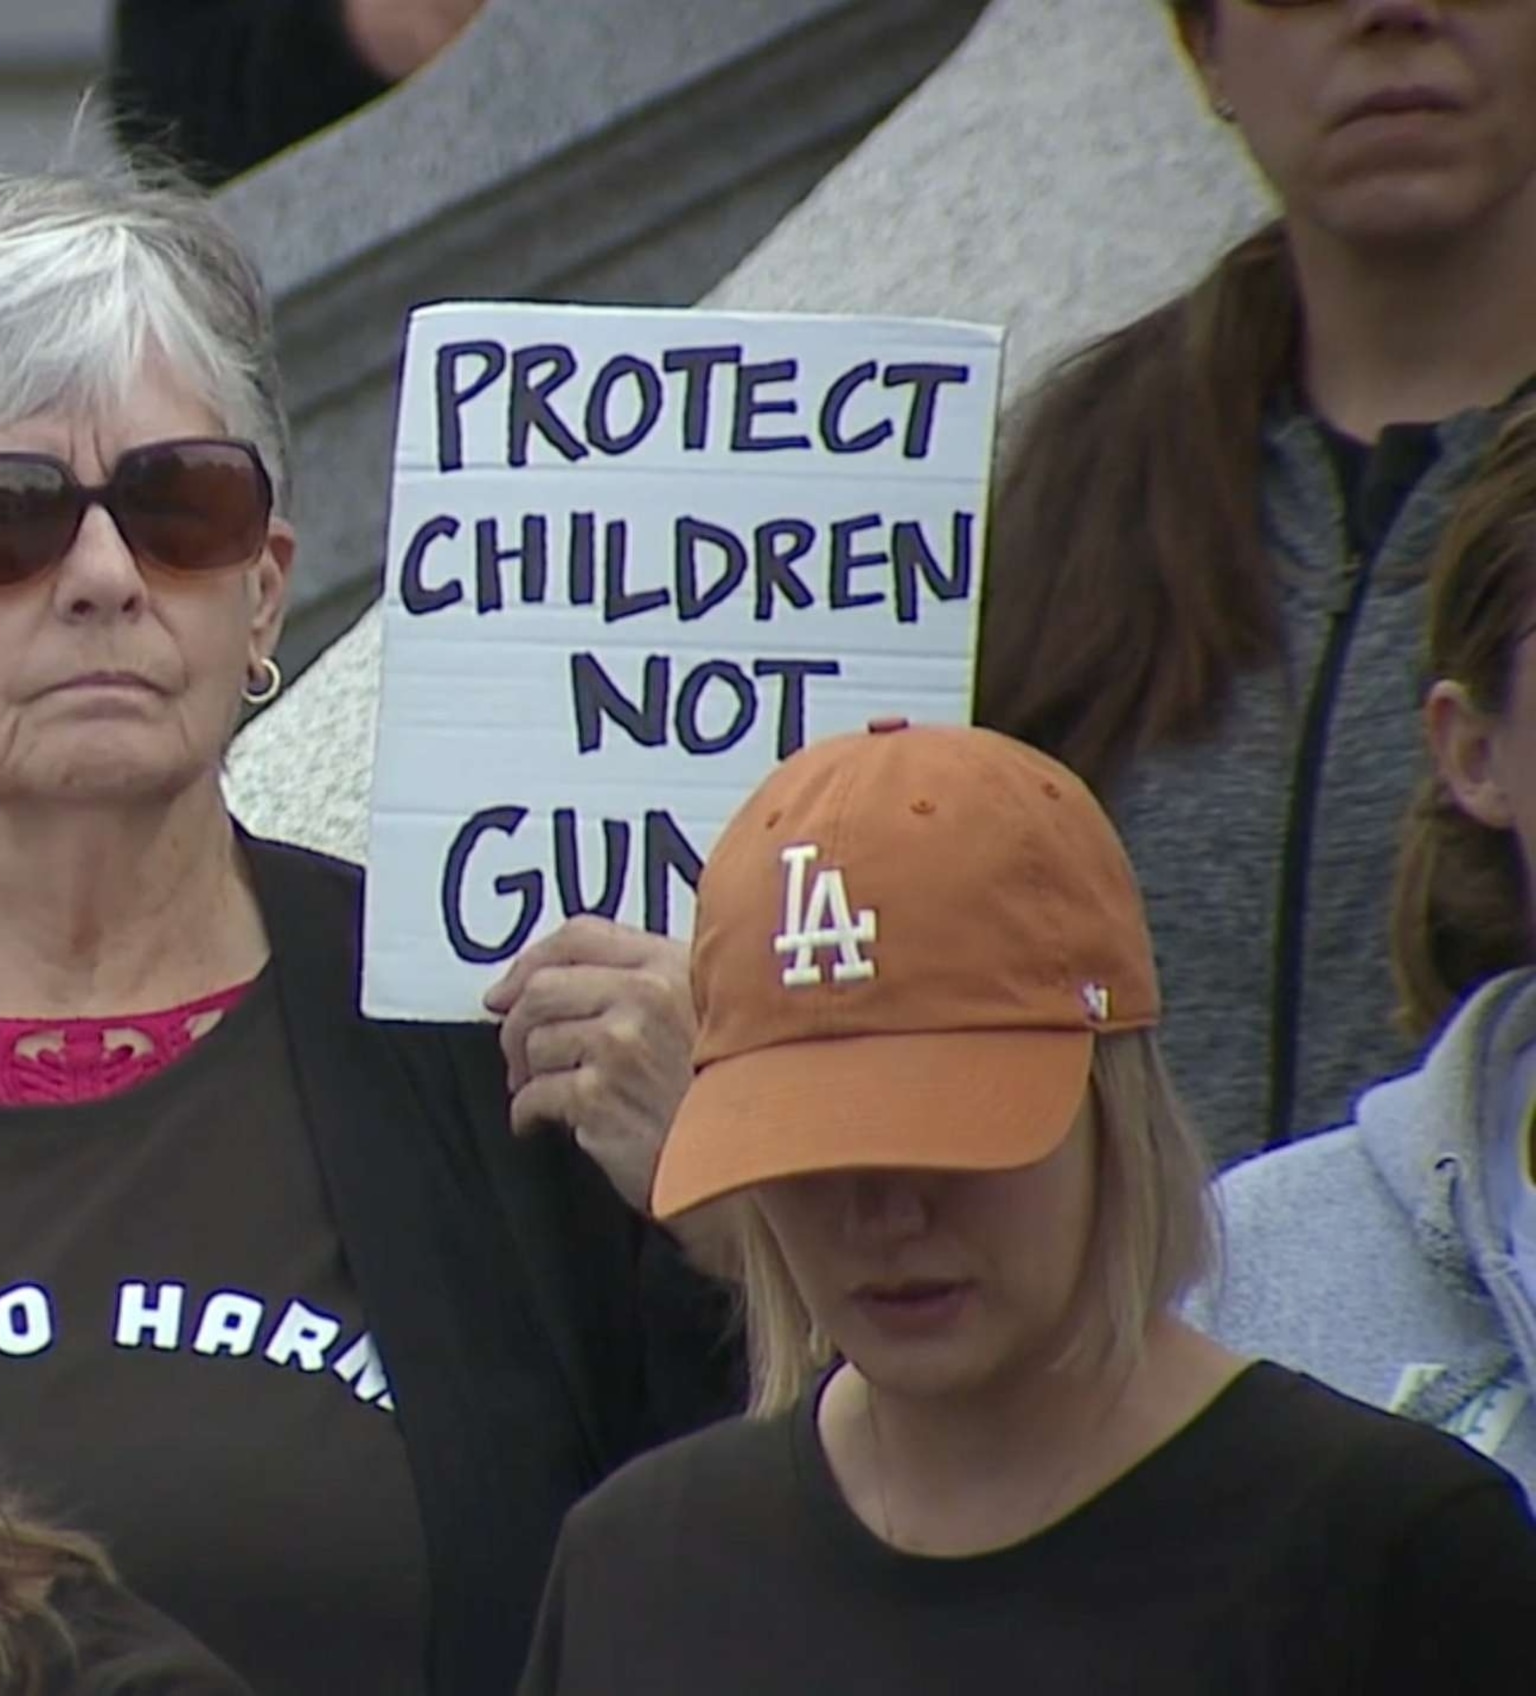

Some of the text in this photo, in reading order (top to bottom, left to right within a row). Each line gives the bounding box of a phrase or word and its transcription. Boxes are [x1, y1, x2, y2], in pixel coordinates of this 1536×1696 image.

[434, 339, 970, 471] PROTECT
[400, 510, 974, 624] CHILDREN
[570, 651, 840, 761] NOT
[774, 843, 877, 987] LA
